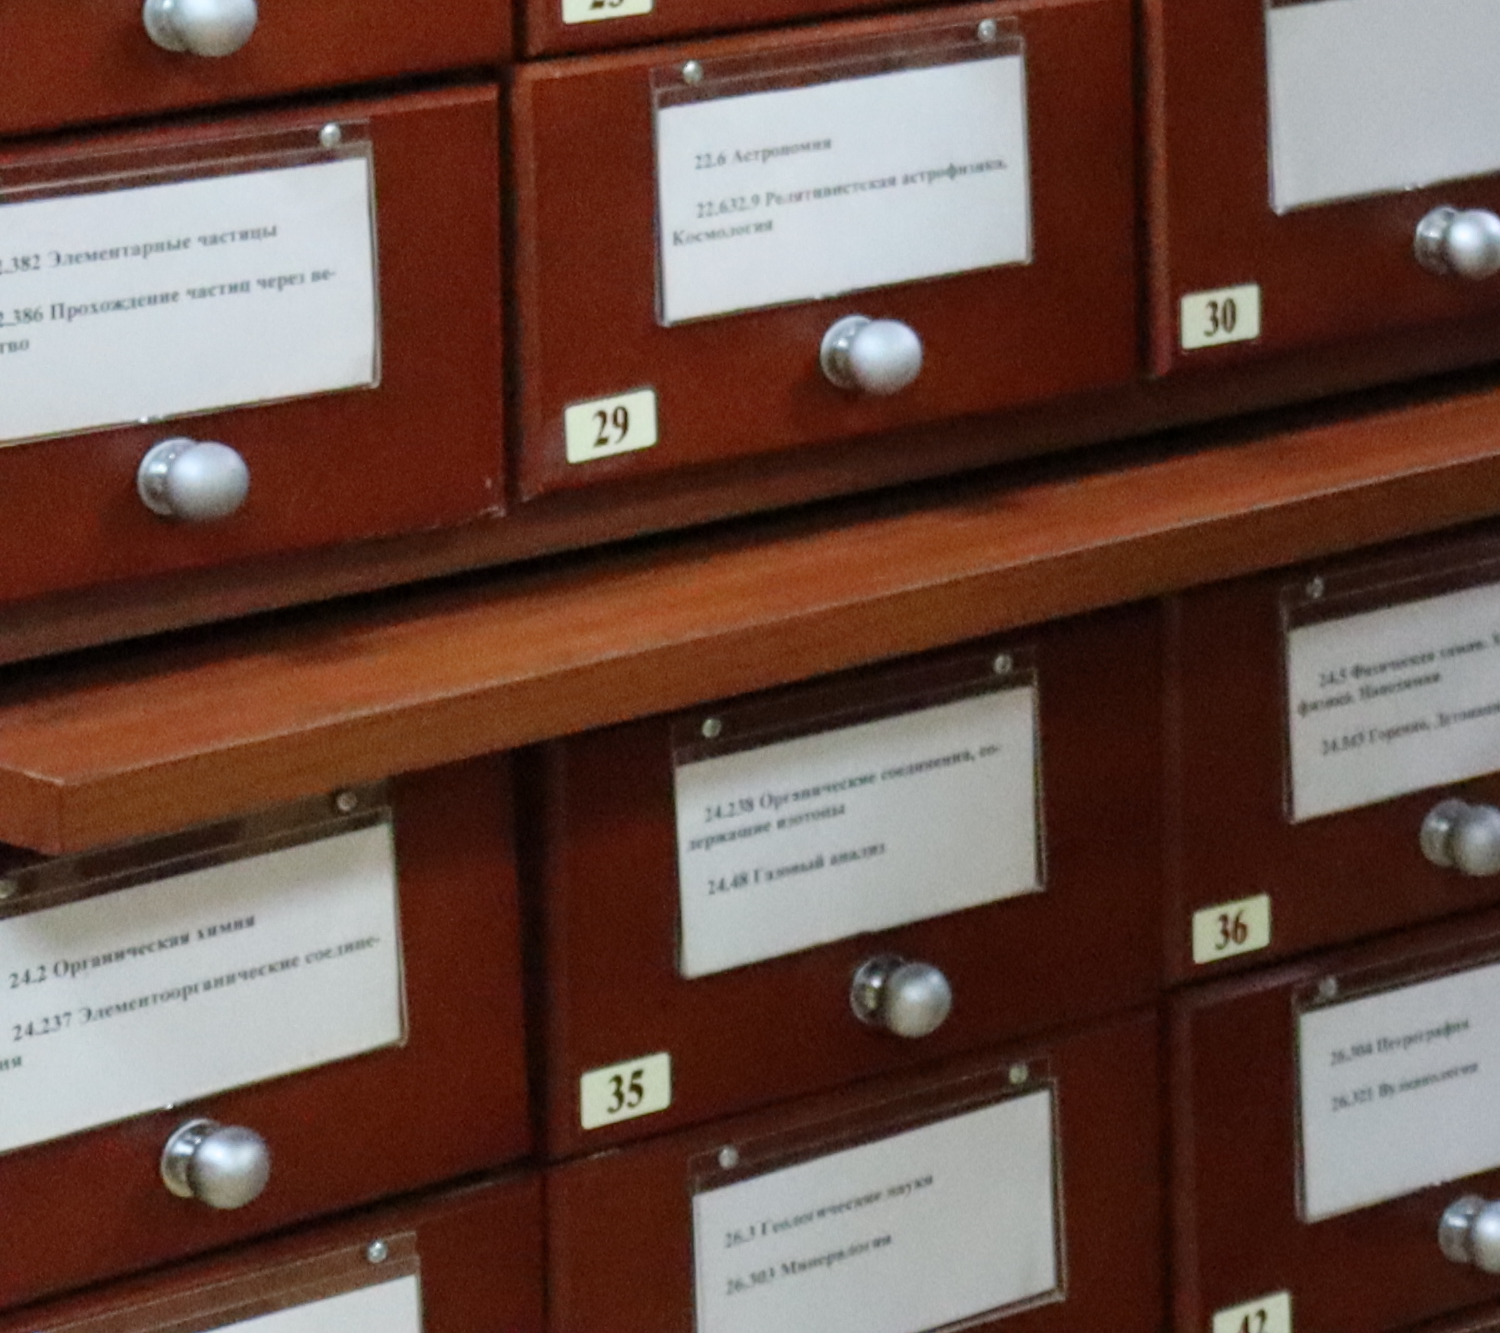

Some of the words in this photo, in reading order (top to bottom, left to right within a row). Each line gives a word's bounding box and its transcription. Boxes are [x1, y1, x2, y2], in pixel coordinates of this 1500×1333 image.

[694, 152, 728, 171] 22.6
[733, 137, 833, 164] Астрономия
[48, 236, 192, 268] Элементарные
[196, 224, 278, 247] частицы
[671, 216, 774, 247] Космология
[49, 290, 180, 323] Прохождение
[185, 279, 251, 300] частиц
[1204, 297, 1238, 338] 30
[593, 405, 630, 448] 29
[1213, 910, 1248, 949] 36
[9, 963, 48, 990] 24.2
[51, 930, 192, 979] Органическая
[194, 912, 256, 941] химия
[12, 1010, 73, 1042] 24.237
[75, 953, 301, 1023] Элементоорганические
[607, 1069, 645, 1111] 35
